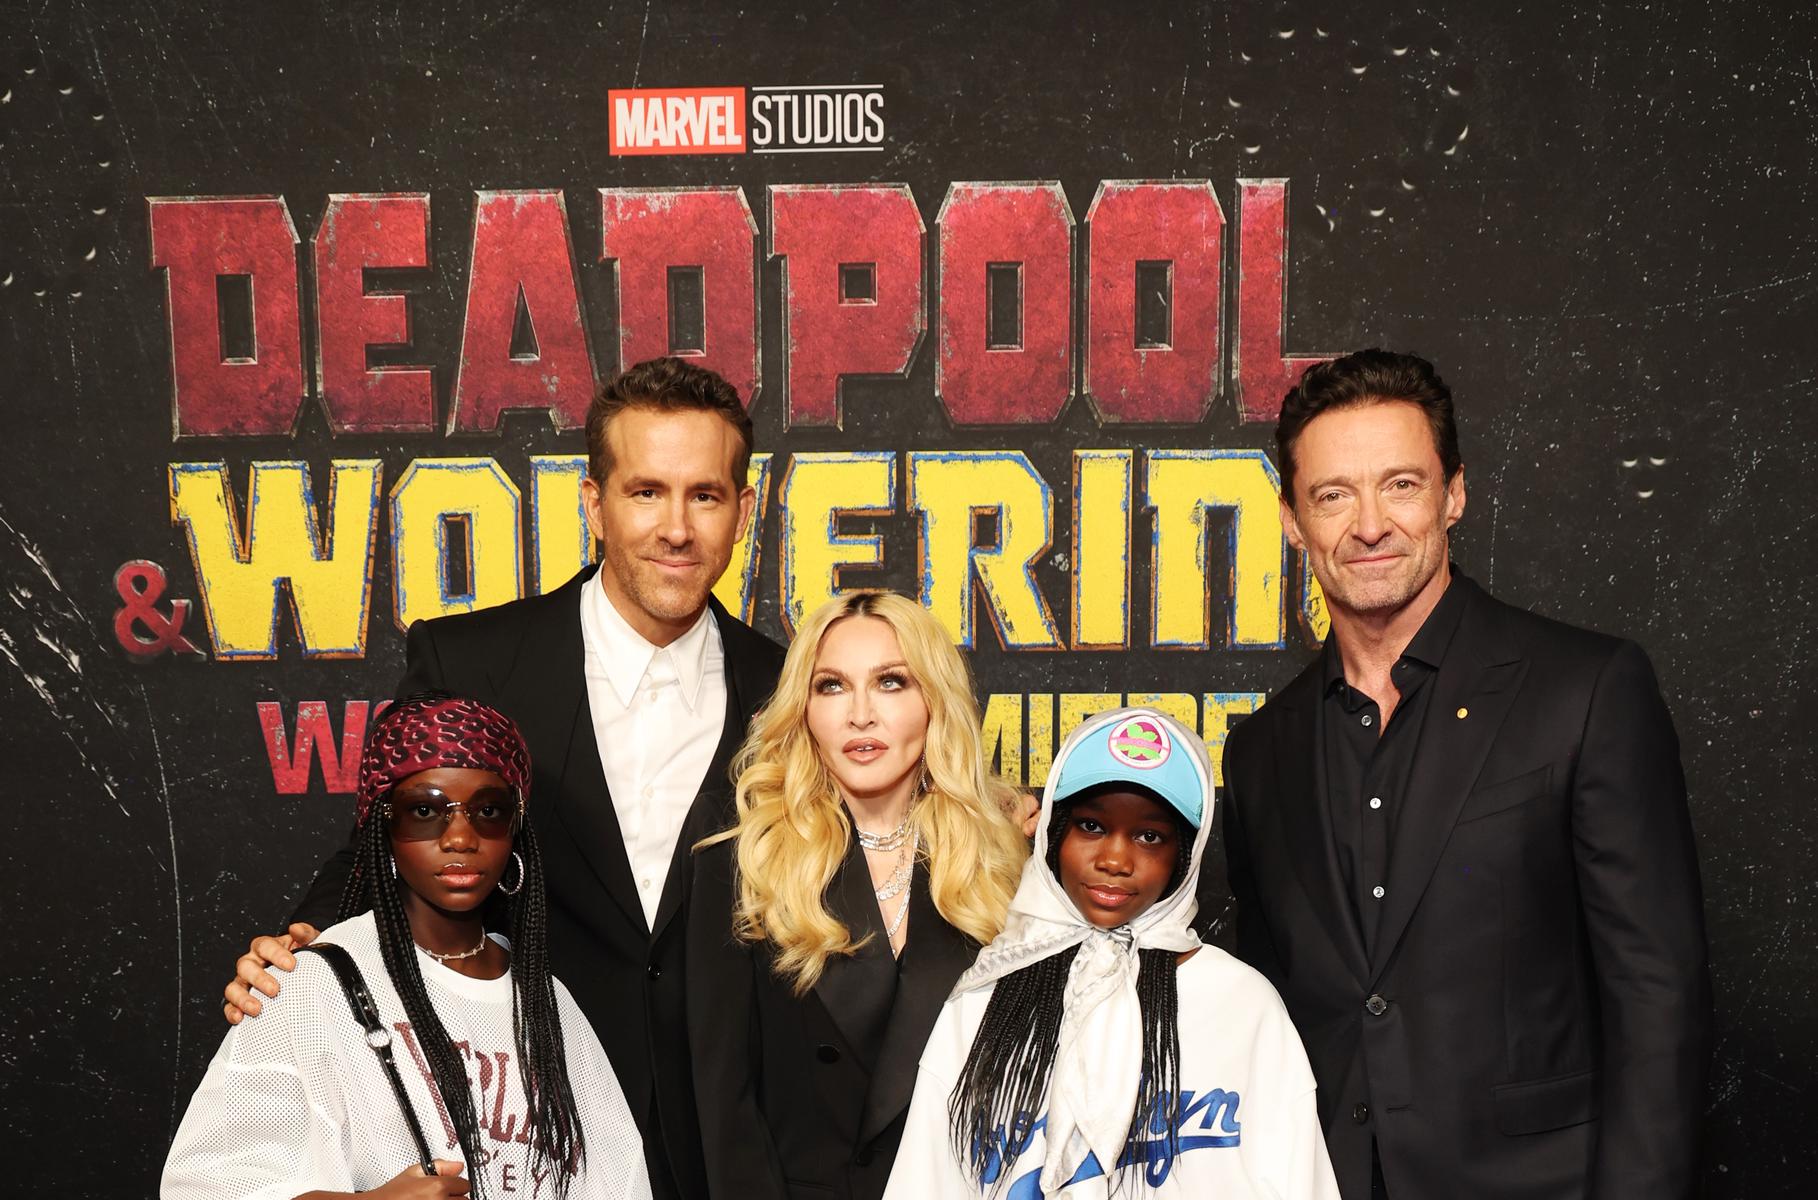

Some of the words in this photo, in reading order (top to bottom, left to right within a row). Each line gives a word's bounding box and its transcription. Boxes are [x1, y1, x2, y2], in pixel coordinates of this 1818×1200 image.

[614, 96, 742, 148] MARVEL
[751, 92, 885, 145] STUDIOS
[145, 177, 1352, 441] DEADPOOL
[113, 559, 206, 663] &
